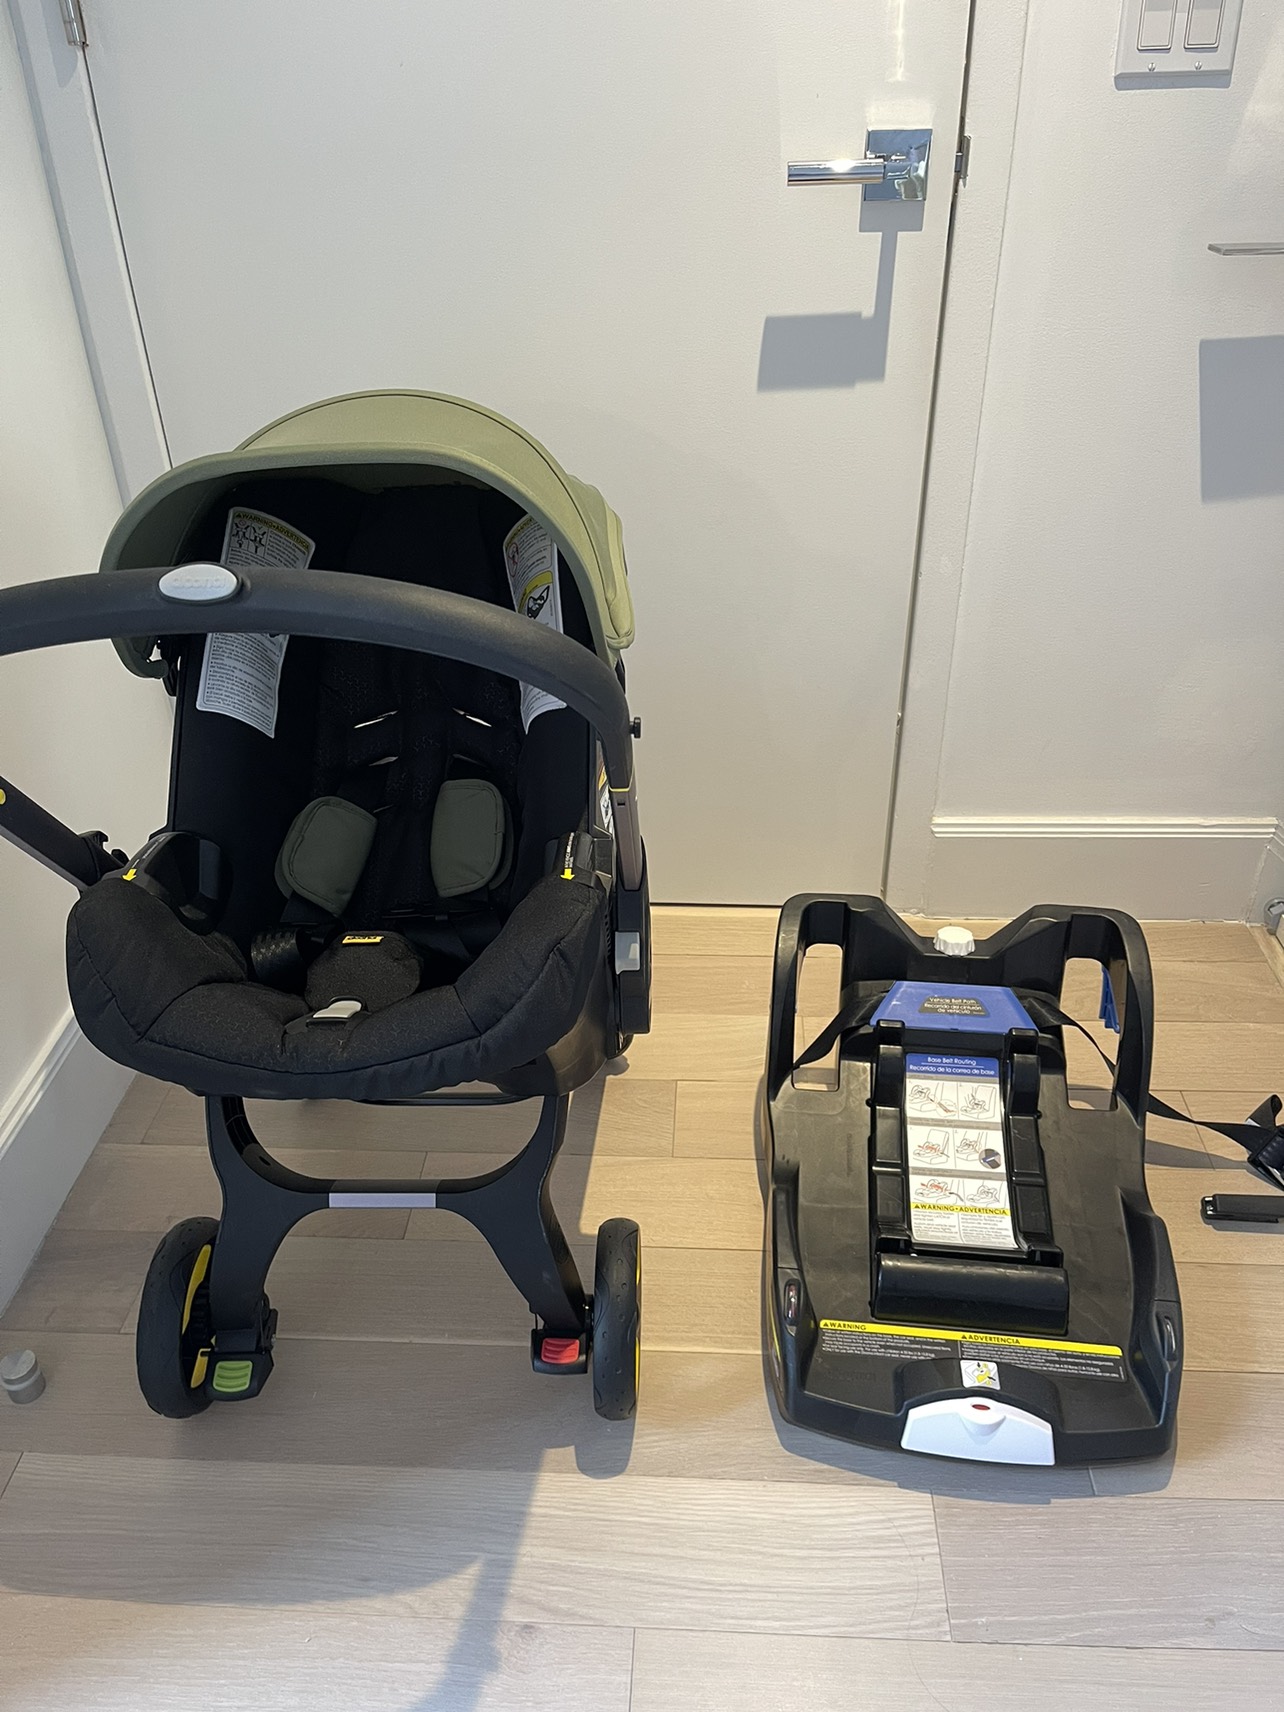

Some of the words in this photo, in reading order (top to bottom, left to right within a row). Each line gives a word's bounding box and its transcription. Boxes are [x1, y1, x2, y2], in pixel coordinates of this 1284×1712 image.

[954, 1058, 976, 1066] Routing
[920, 1203, 954, 1211] WARNING
[960, 1205, 1007, 1215] ADVERTENCIA
[829, 1322, 867, 1331] WARNING
[968, 1334, 1021, 1345] ADVERTENCIA
